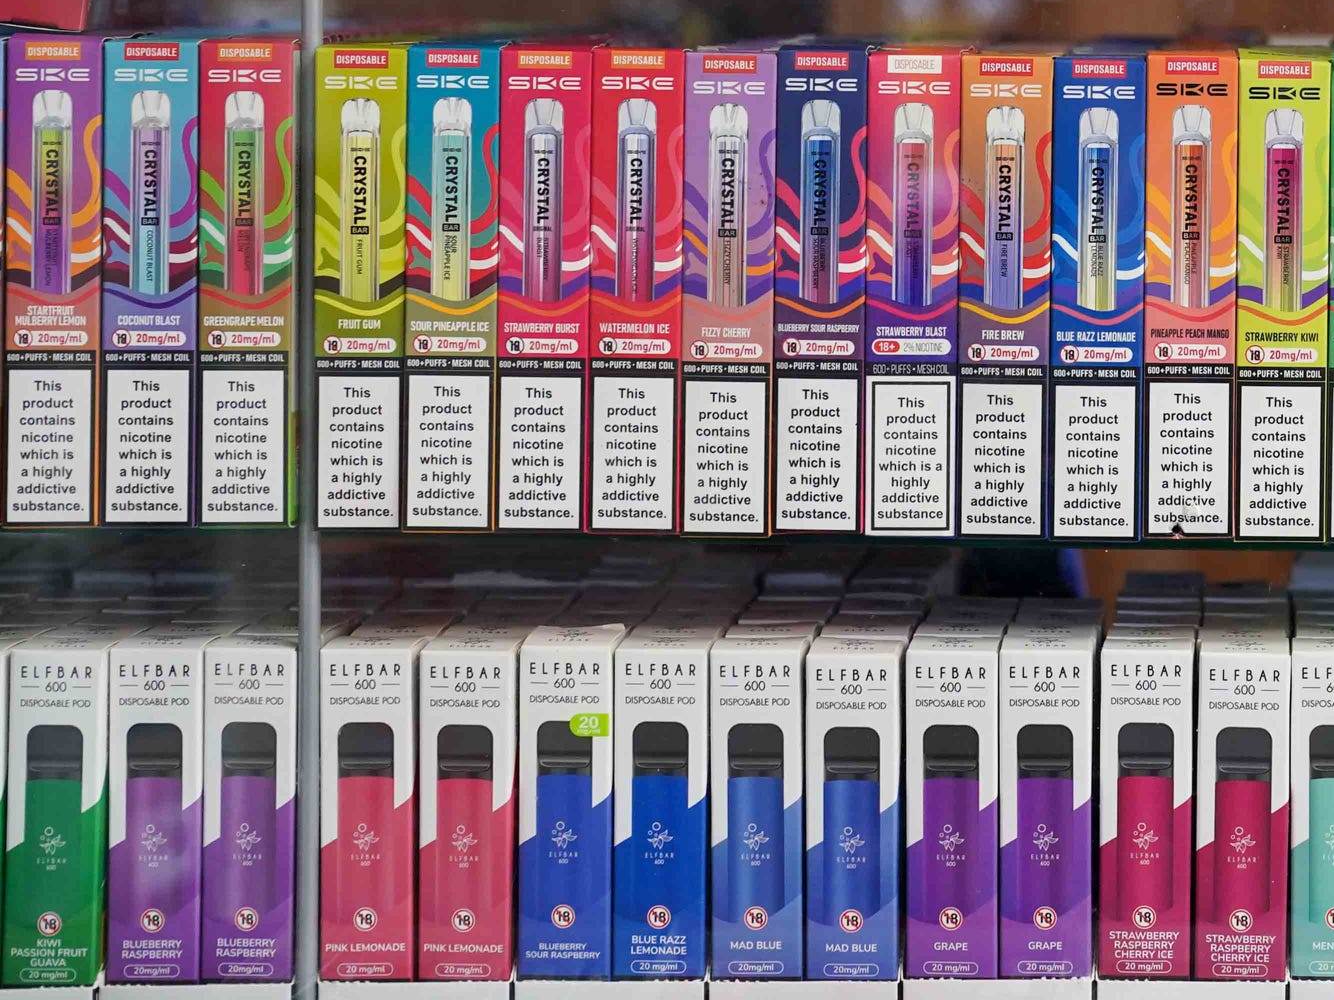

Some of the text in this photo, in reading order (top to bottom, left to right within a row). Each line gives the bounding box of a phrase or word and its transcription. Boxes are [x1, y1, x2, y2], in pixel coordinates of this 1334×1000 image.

[126, 47, 178, 58] DISPOSABLE
[114, 68, 188, 83] SKE
[1063, 85, 1136, 100] SKE
[143, 149, 158, 217] CRYSTAL
[27, 305, 74, 316] STARTFRUIT
[14, 315, 87, 326] MULBERRY LEMON
[117, 315, 181, 326] COCONUT BLAST
[203, 316, 284, 326] GREENGRAPE MELON
[338, 319, 381, 329] FRUIT GUM
[135, 333, 180, 345] 20mg/ml
[982, 330, 1025, 340] FIRE BREW
[1056, 331, 1136, 342] BLUE RAZZ LEMONADE
[1245, 332, 1319, 342] STRAWBERRY KIWI
[149, 353, 172, 362] MESH
[172, 353, 190, 362] COIL
[34, 380, 62, 392] This
[22, 398, 74, 409] product
[19, 415, 76, 426] contains
[21, 432, 74, 443] nicotine
[20, 449, 74, 461] which is
[21, 466, 73, 480] a highly
[16, 483, 77, 494] addictive
[12, 500, 84, 512] substance.
[21, 665, 92, 679] ELFBAR
[44, 681, 67, 693] 600
[20, 698, 91, 708] DISPOSABLE POD
[1108, 931, 1180, 941] STRAWBERRY
[36, 938, 61, 948] KIWI
[325, 943, 406, 952] PINK LEMONADE
[730, 940, 782, 951] MAD BLUE
[933, 941, 968, 952] GRAPE
[1113, 940, 1175, 950] RASPBERRY
[10, 947, 88, 958] PASSION FRUIT
[1114, 949, 1173, 959] CHERRY ICE
[29, 958, 67, 967] GUAVA
